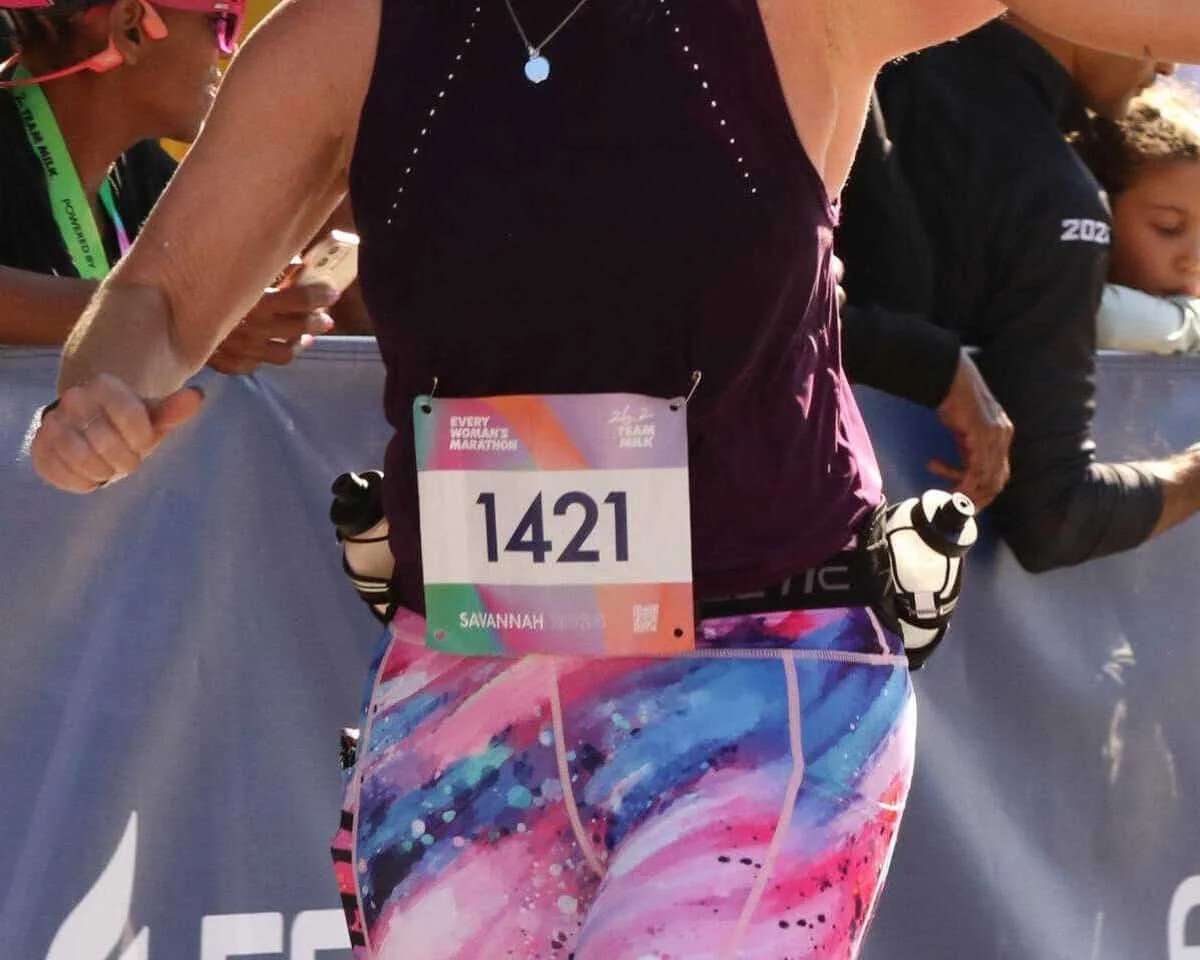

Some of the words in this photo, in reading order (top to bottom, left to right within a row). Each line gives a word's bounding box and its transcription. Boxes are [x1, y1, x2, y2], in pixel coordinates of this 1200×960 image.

[61, 197, 91, 253] POWERED
[450, 415, 491, 428] EVERY
[449, 427, 510, 439] WOMAN'S
[617, 424, 656, 437] TEAM
[449, 439, 518, 451] MARATHON
[475, 489, 630, 564] 1421
[458, 611, 545, 630] SAVANNAH
